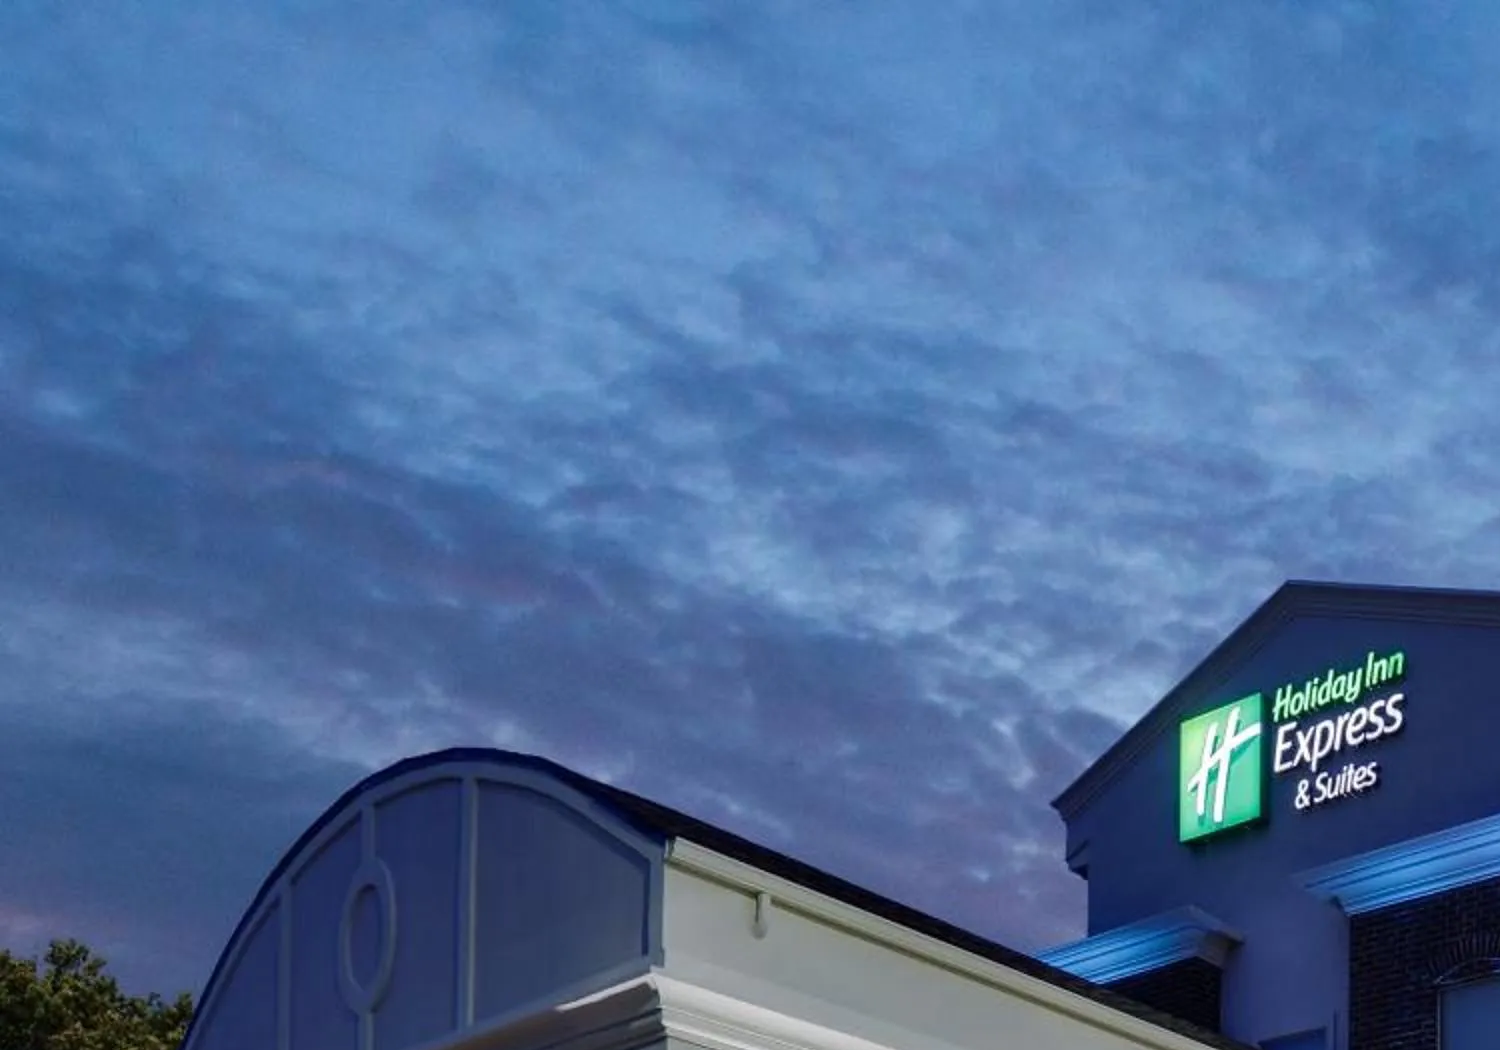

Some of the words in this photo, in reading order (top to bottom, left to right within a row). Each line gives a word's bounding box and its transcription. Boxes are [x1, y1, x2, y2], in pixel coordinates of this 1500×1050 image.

[1272, 669, 1362, 722] Holiday
[1365, 651, 1405, 688] Inn
[1273, 693, 1404, 773] Express
[1295, 779, 1310, 809] &
[1313, 761, 1377, 802] Suites
